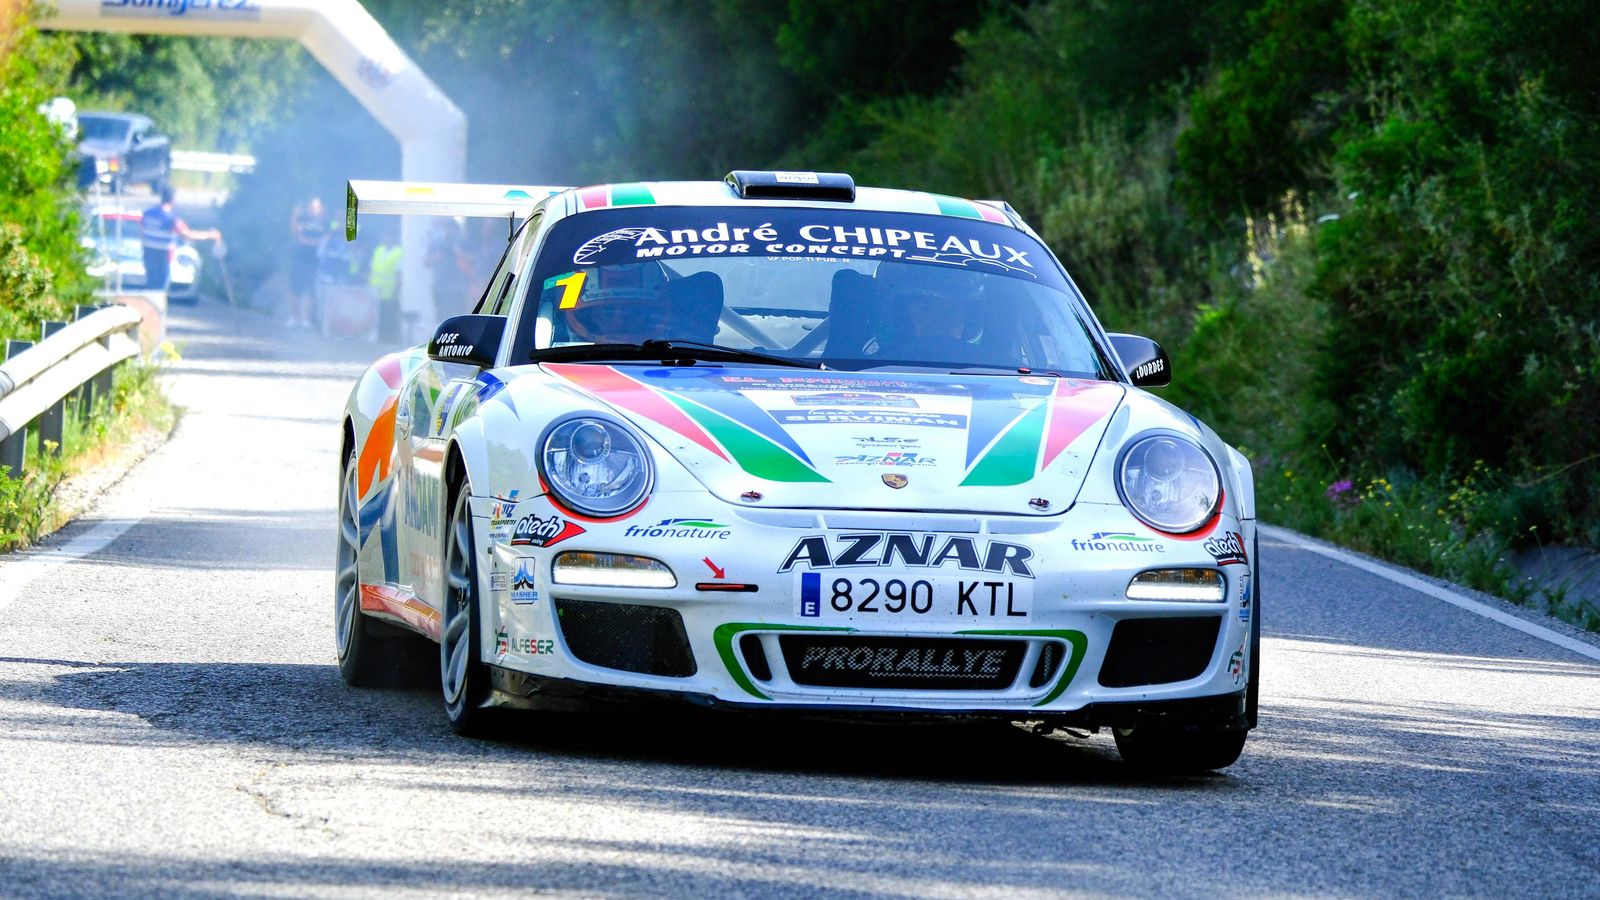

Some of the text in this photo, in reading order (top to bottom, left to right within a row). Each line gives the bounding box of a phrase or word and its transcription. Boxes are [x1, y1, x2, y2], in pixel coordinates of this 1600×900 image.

[634, 222, 1034, 268] André CHIPEAUX
[636, 243, 906, 259] MOTOR CONCEPT
[556, 272, 588, 309] 1
[436, 332, 460, 345] JOSE
[438, 344, 474, 357] ANTONIO
[1136, 358, 1164, 378] LOURDES
[784, 414, 959, 427] SERVIMAN
[513, 514, 559, 540] atech
[624, 525, 732, 541] frionature
[1071, 539, 1165, 554] frionature
[777, 533, 1035, 579] AZNAR
[831, 578, 1027, 616] 8290 KTL
[804, 602, 816, 615] E
[512, 638, 554, 655] ALFESER
[802, 646, 1006, 674] PRORALLYE
